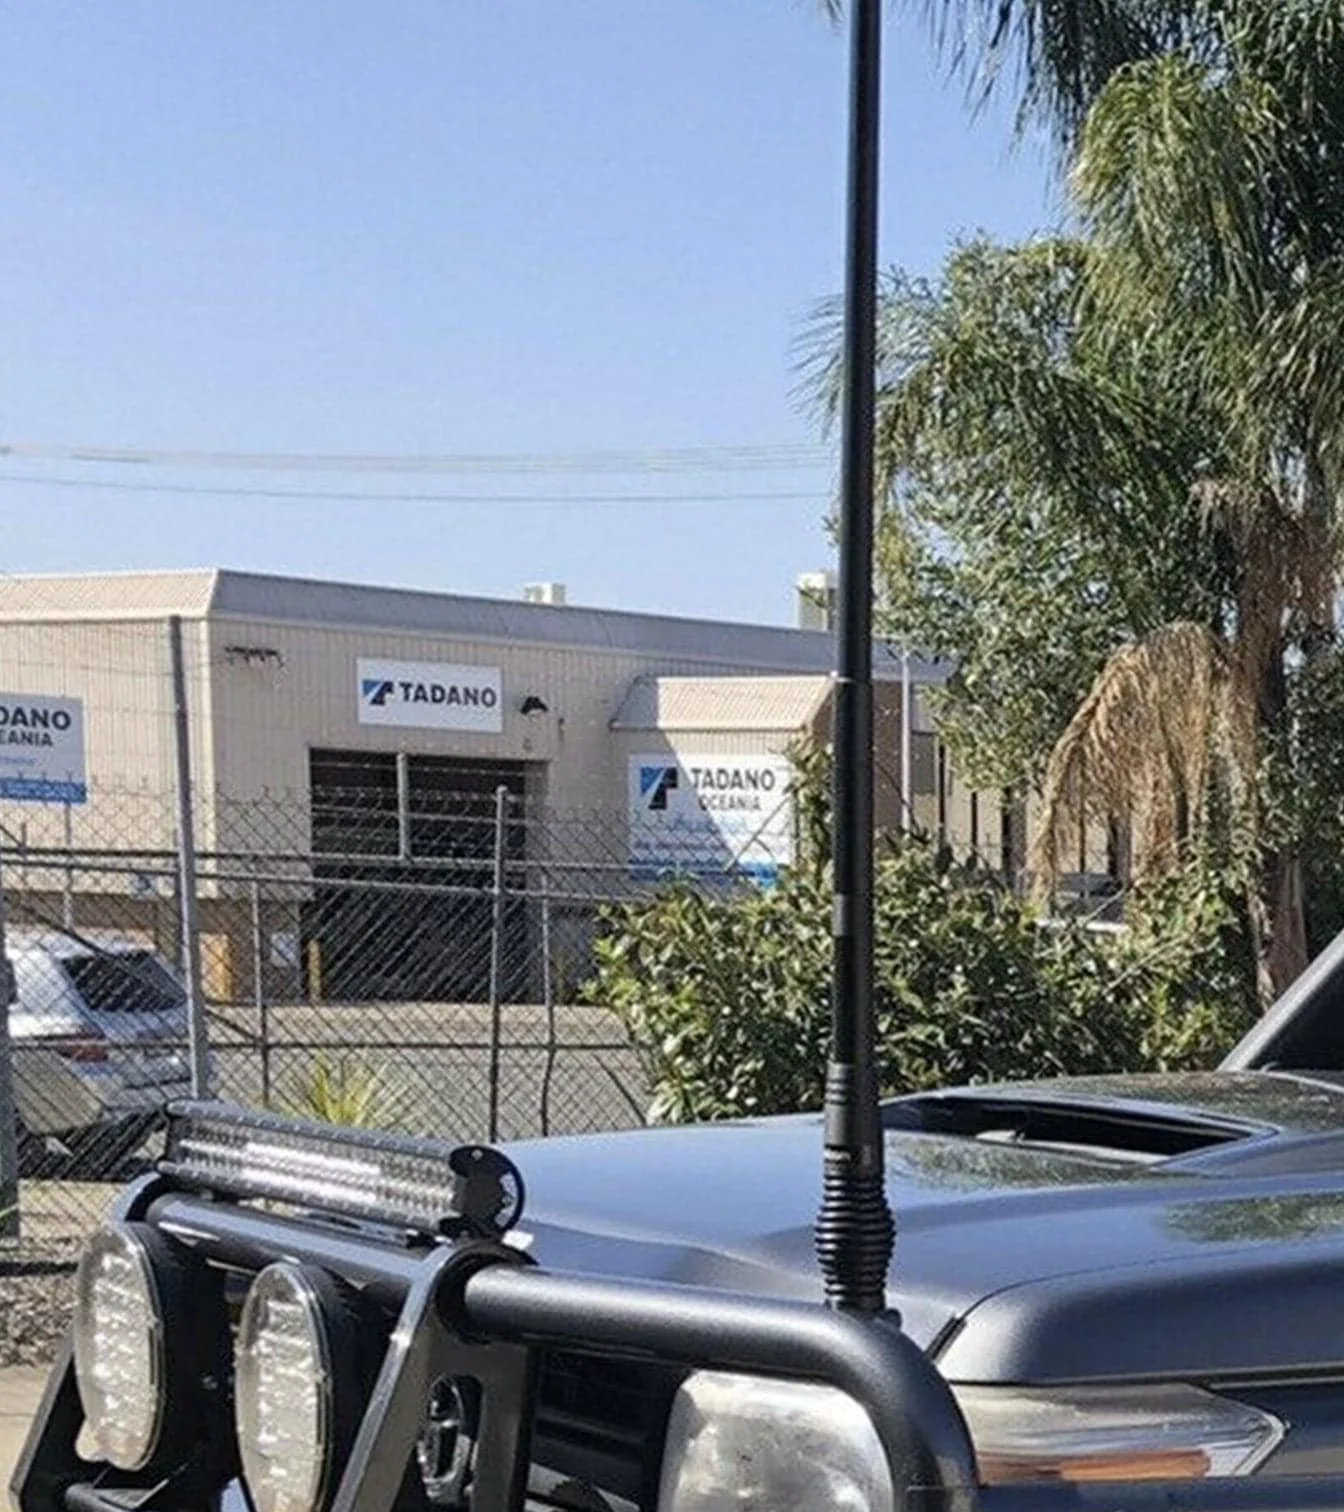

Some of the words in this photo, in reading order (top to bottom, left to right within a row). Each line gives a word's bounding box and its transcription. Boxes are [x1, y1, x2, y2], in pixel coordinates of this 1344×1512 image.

[399, 681, 498, 708] TADANO
[692, 767, 777, 792] TADANO
[698, 793, 763, 811] OCEANIA
